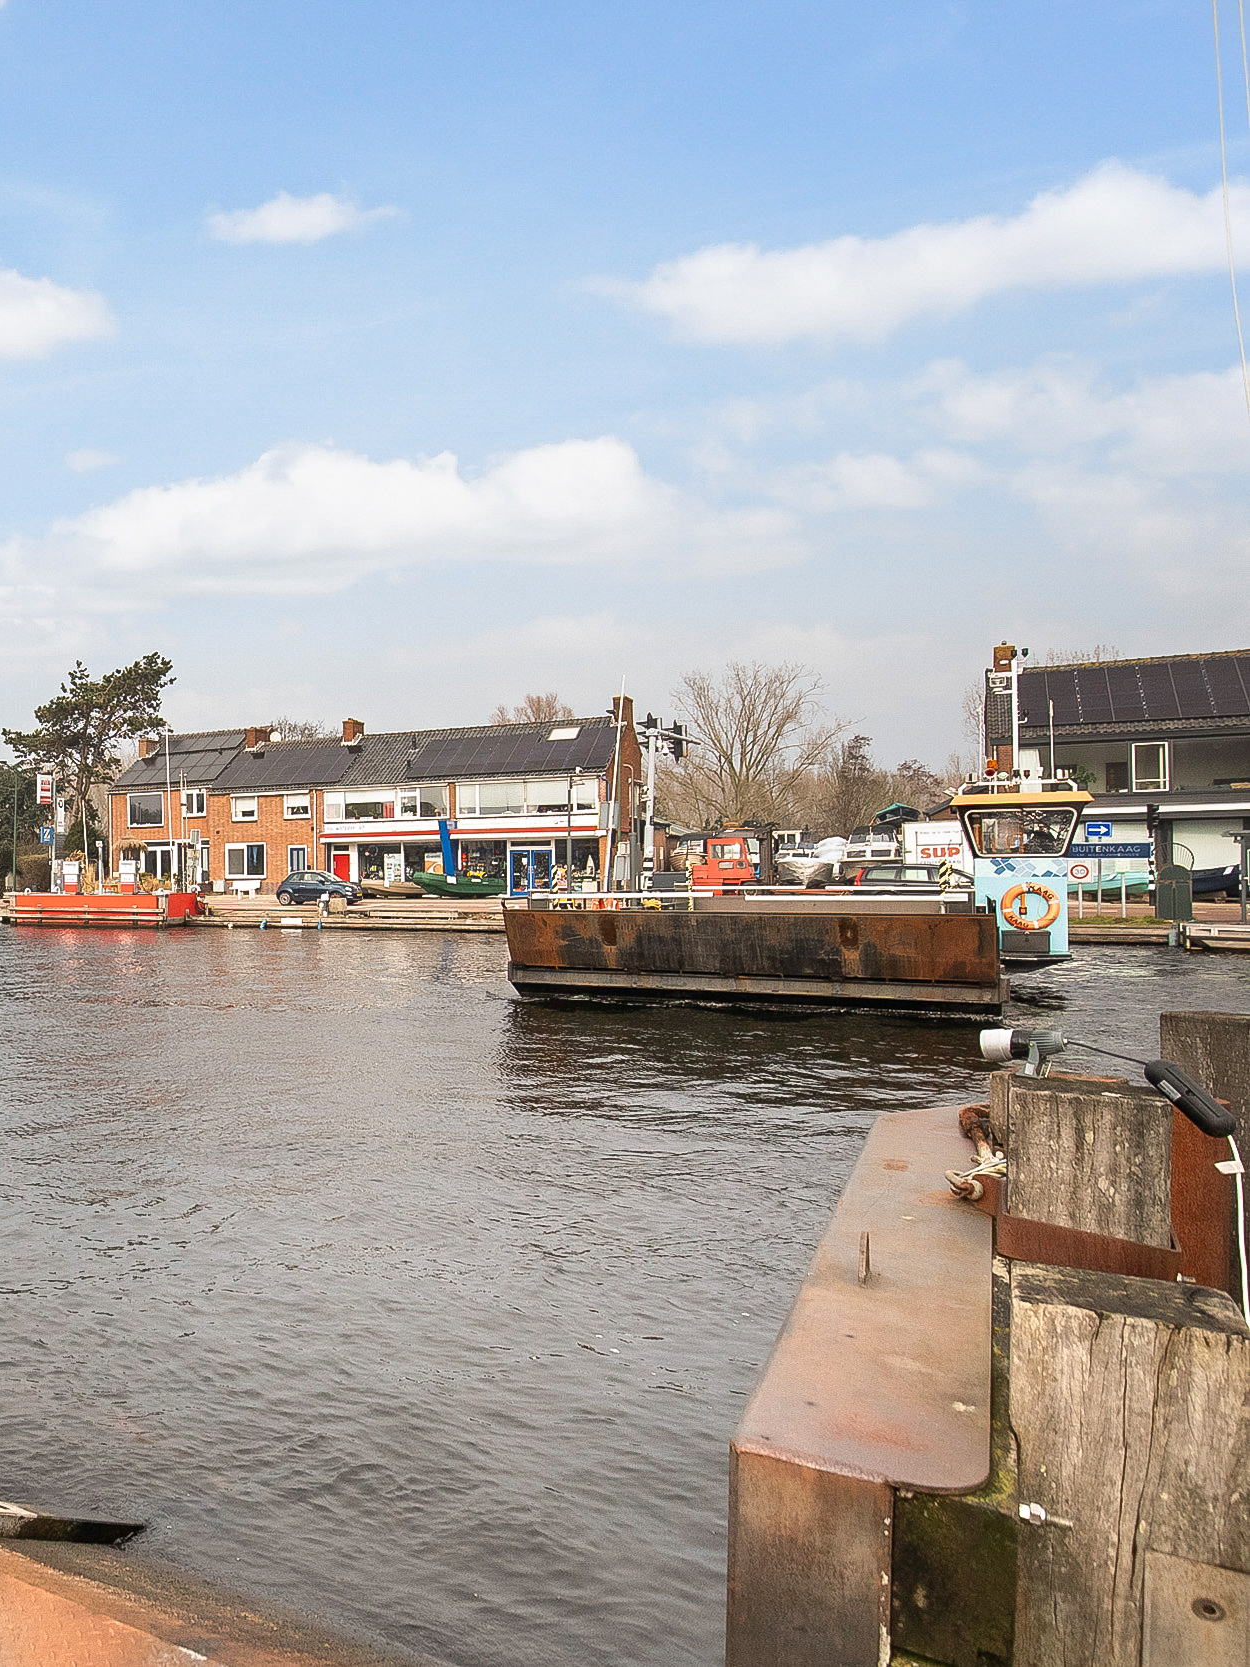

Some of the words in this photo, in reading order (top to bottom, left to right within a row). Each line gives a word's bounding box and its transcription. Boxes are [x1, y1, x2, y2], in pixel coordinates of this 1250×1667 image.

[920, 847, 961, 858] SUP
[1072, 845, 1141, 853] BUITENKAAG
[1074, 868, 1086, 876] 30
[1030, 885, 1055, 900] KAAG
